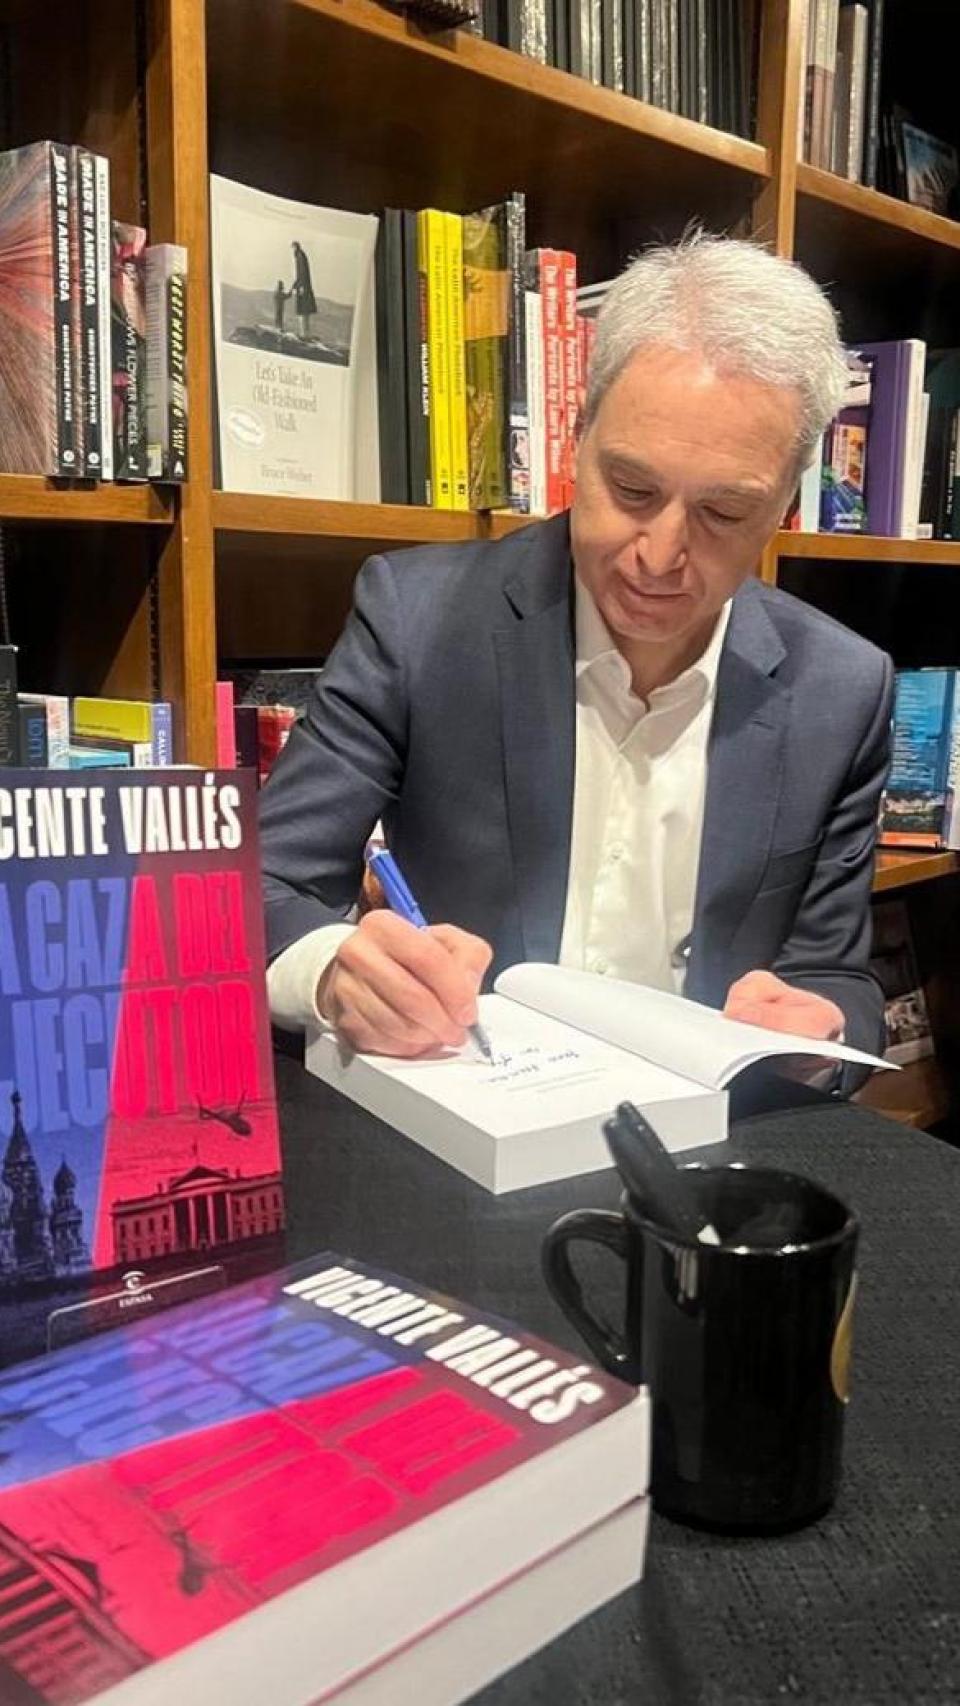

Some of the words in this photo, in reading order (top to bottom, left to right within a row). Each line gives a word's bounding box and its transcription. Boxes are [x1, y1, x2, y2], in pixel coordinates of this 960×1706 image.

[54, 155, 69, 207] MADE
[81, 160, 95, 213] MADE
[57, 225, 70, 301] AMERICA
[84, 230, 96, 306] AMERICA
[126, 349, 138, 401] FLOWER
[421, 343, 430, 384] WILLIAM
[119, 772, 242, 854] VALLÉS
[26, 875, 168, 993] CAZA
[172, 871, 251, 979] DEL
[282, 1266, 466, 1346] VICENTE
[425, 1324, 605, 1425] VALLÉS
[208, 1322, 424, 1432] CAZA
[337, 1388, 521, 1498] DEL
